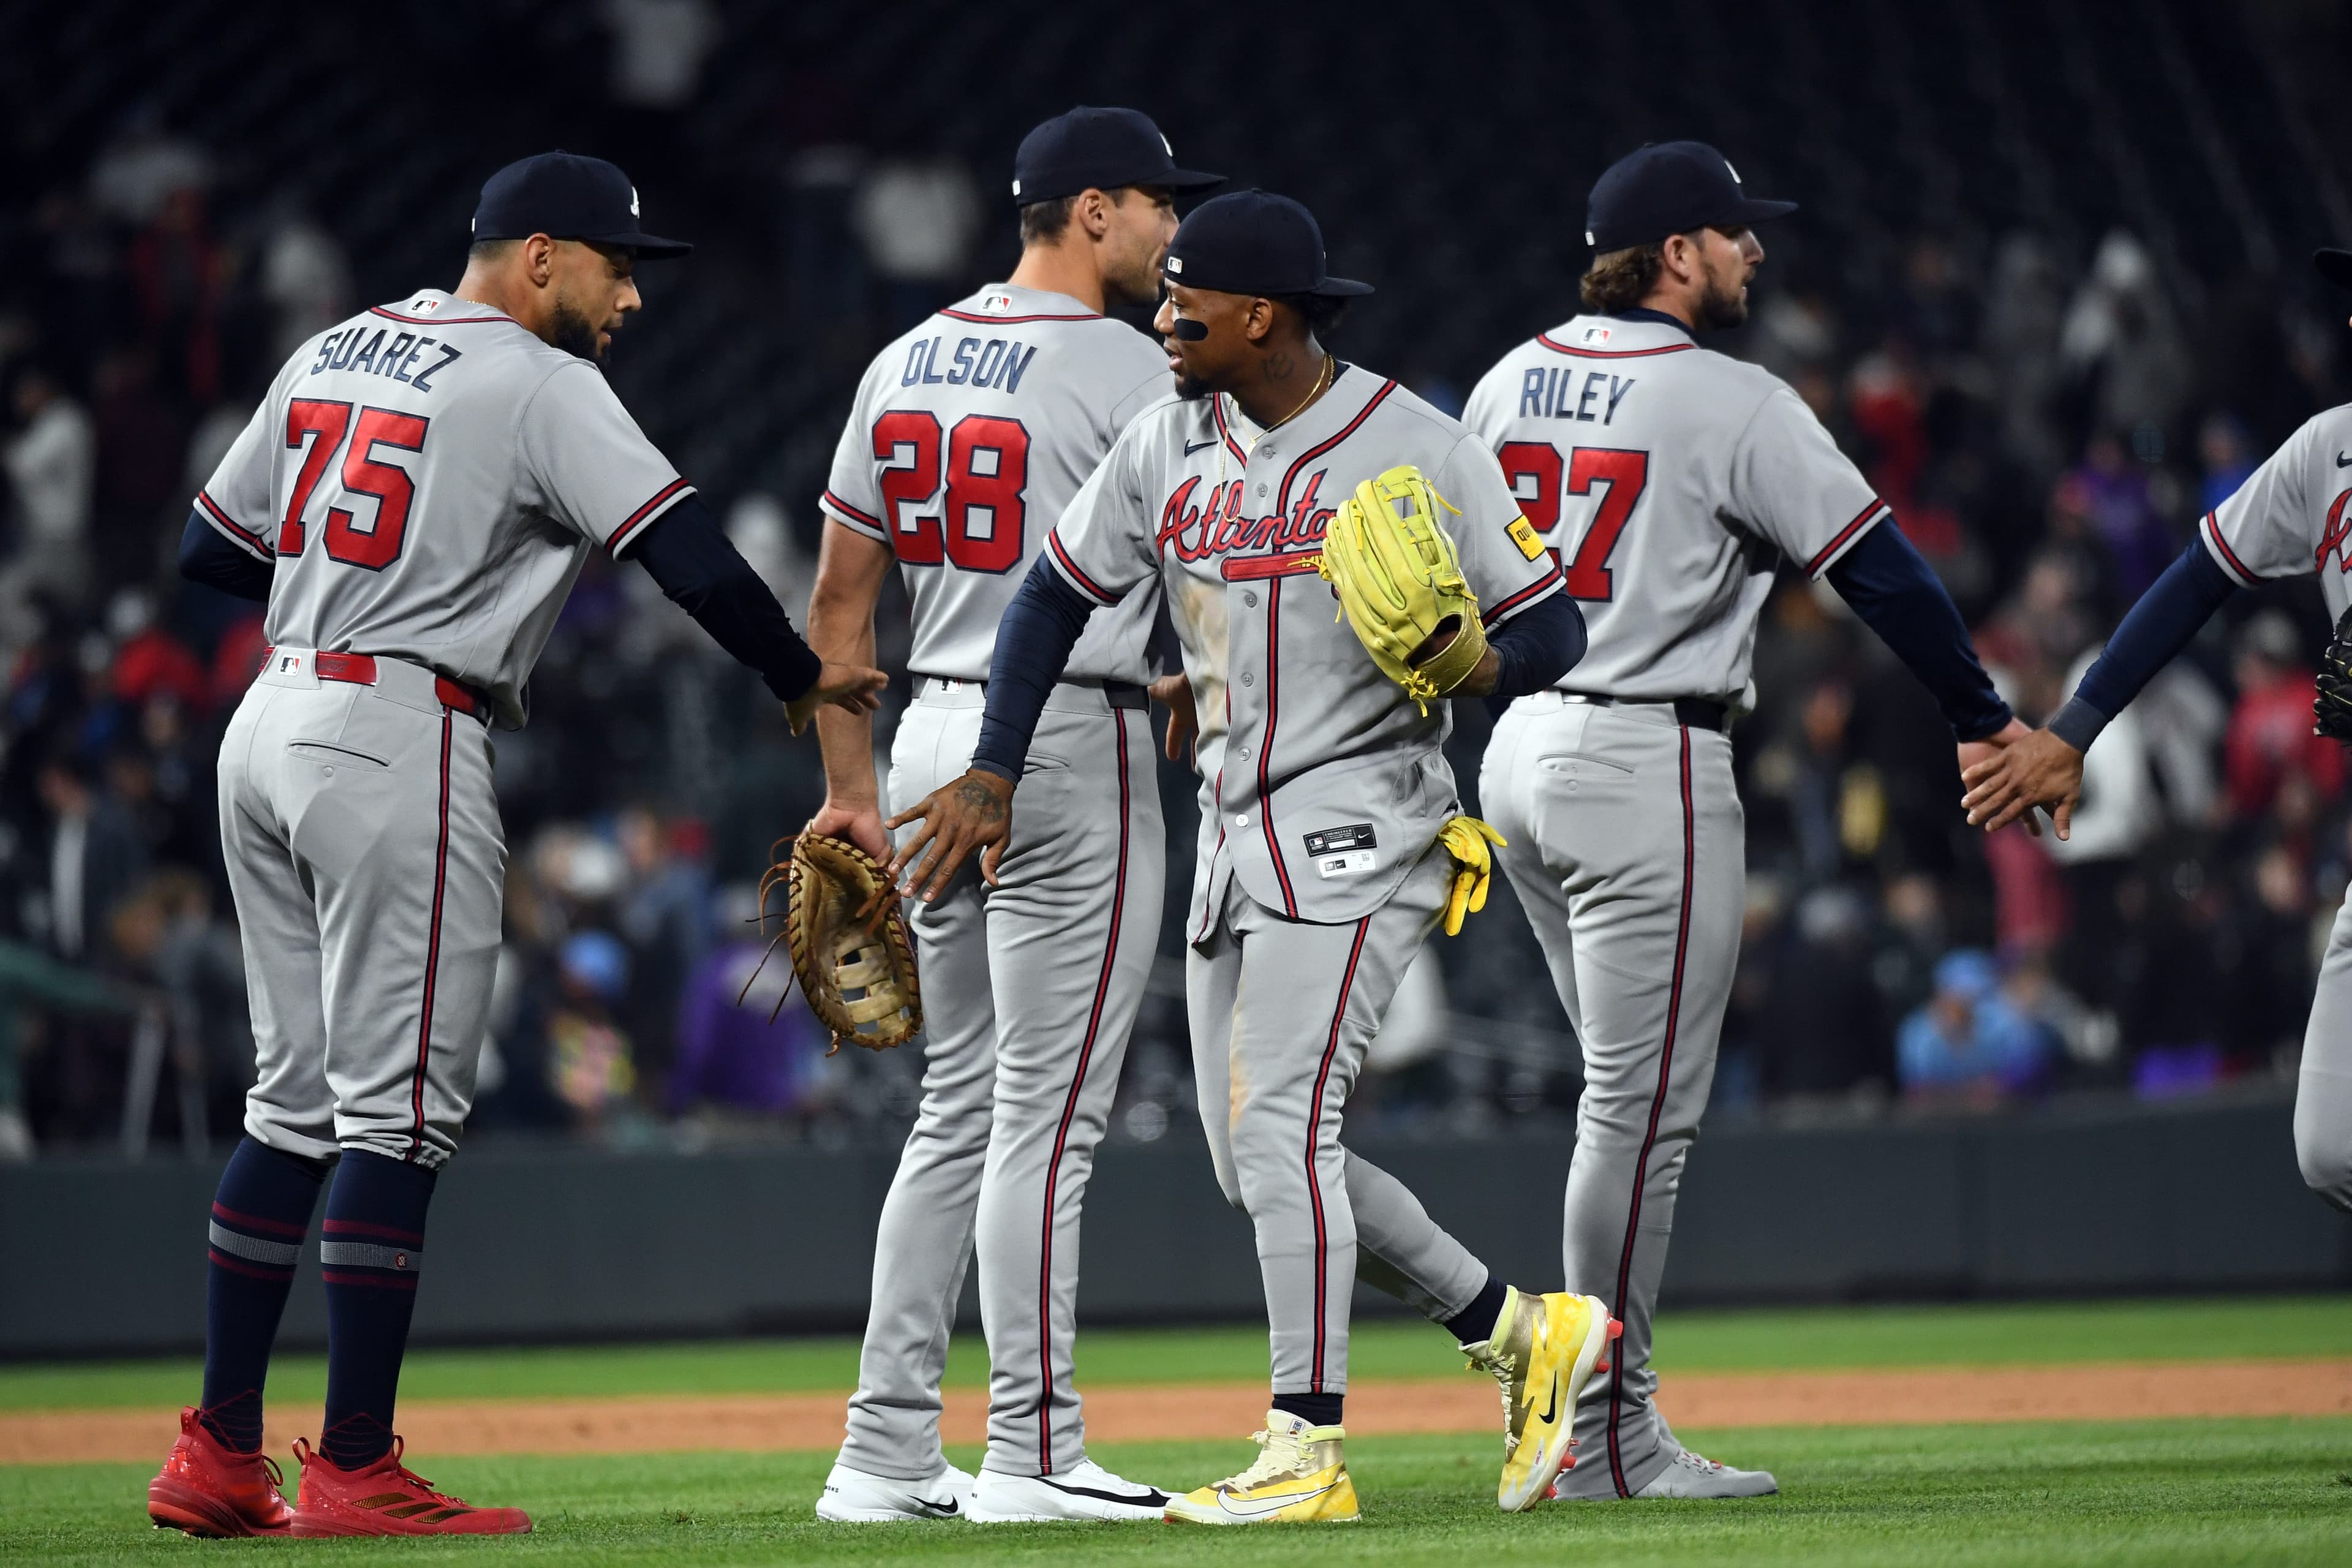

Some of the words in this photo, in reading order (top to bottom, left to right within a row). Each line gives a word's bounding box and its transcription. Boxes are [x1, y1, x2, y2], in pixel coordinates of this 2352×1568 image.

[311, 327, 462, 393] SUAREZ
[902, 337, 1038, 394] OLSON
[1520, 368, 1635, 426] RILEY
[277, 398, 430, 572] 75
[872, 410, 1031, 575] 28
[1156, 468, 1338, 564] Atlanta
[1497, 441, 1649, 602] 27
